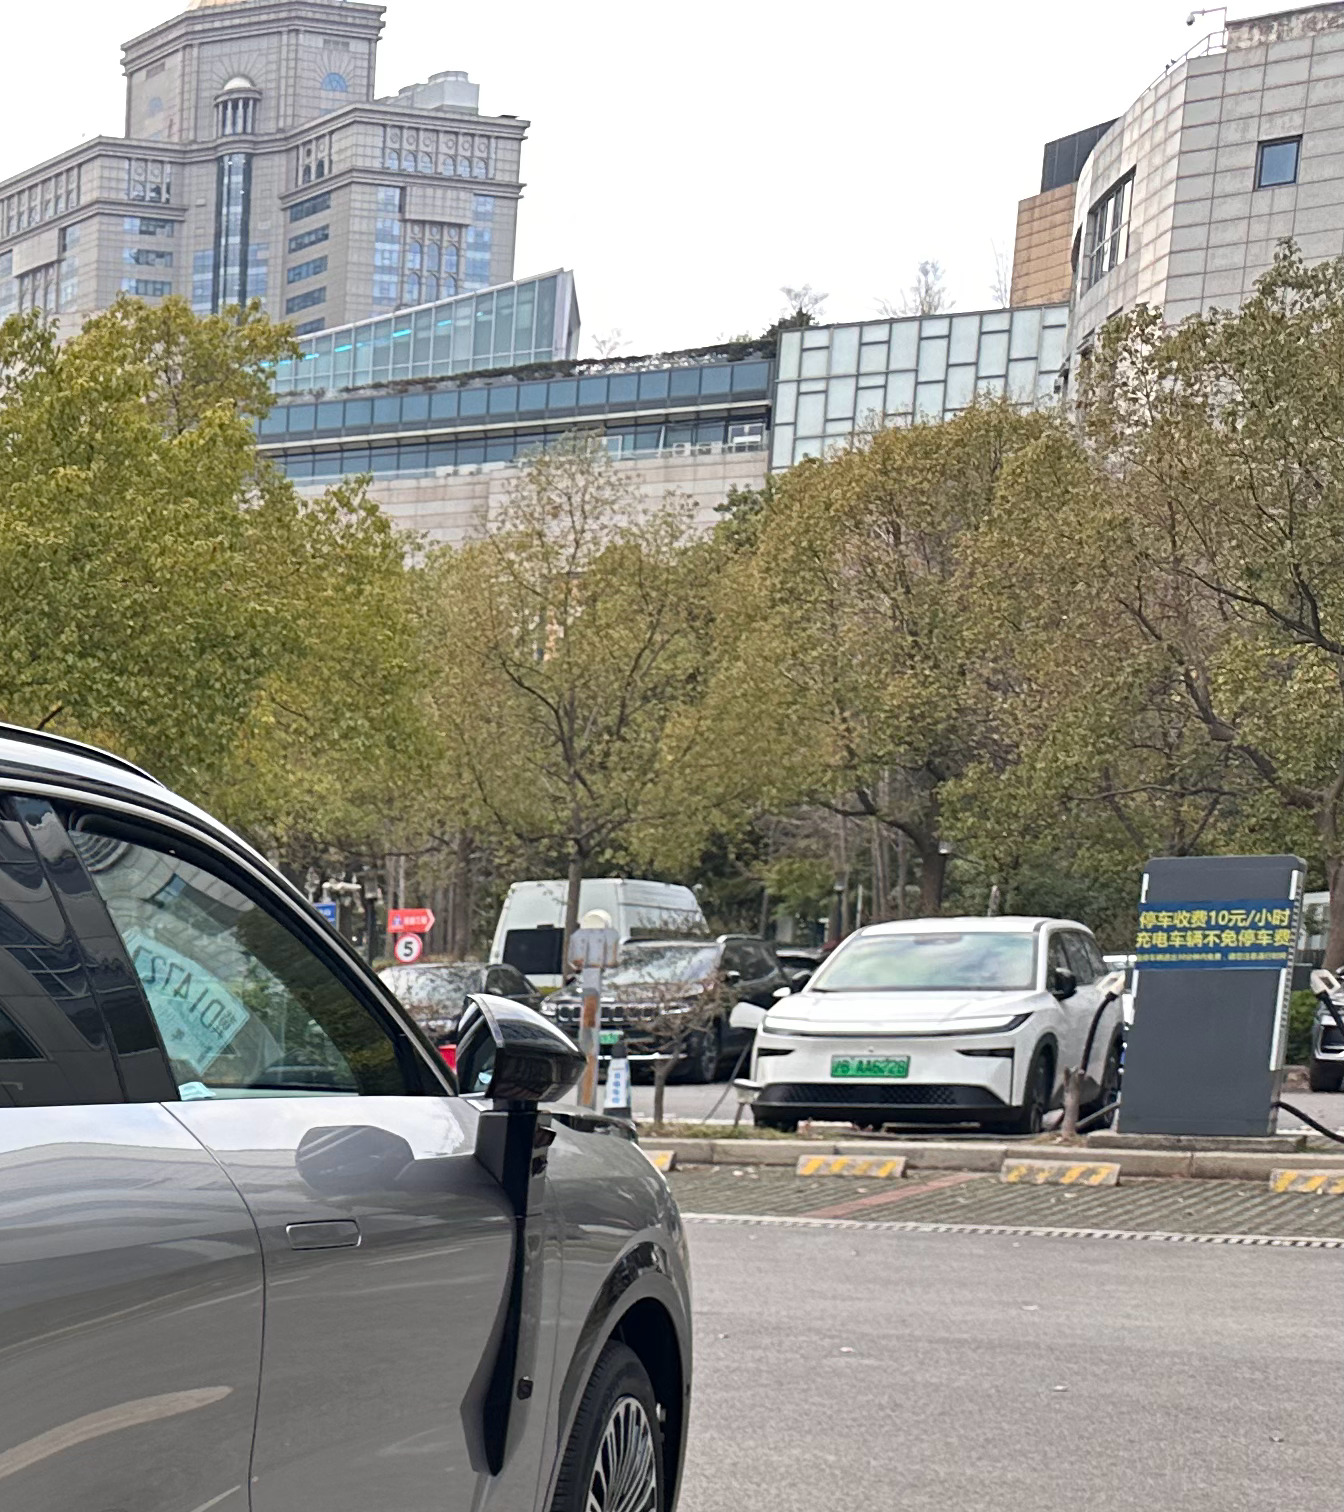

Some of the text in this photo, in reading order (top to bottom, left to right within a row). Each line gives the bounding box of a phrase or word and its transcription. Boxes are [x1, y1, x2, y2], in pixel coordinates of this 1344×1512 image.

[1139, 909, 1291, 929] 停车收费10元/小时
[1135, 929, 1291, 948] 充电车辆不免停车费
[403, 941, 414, 957] 5
